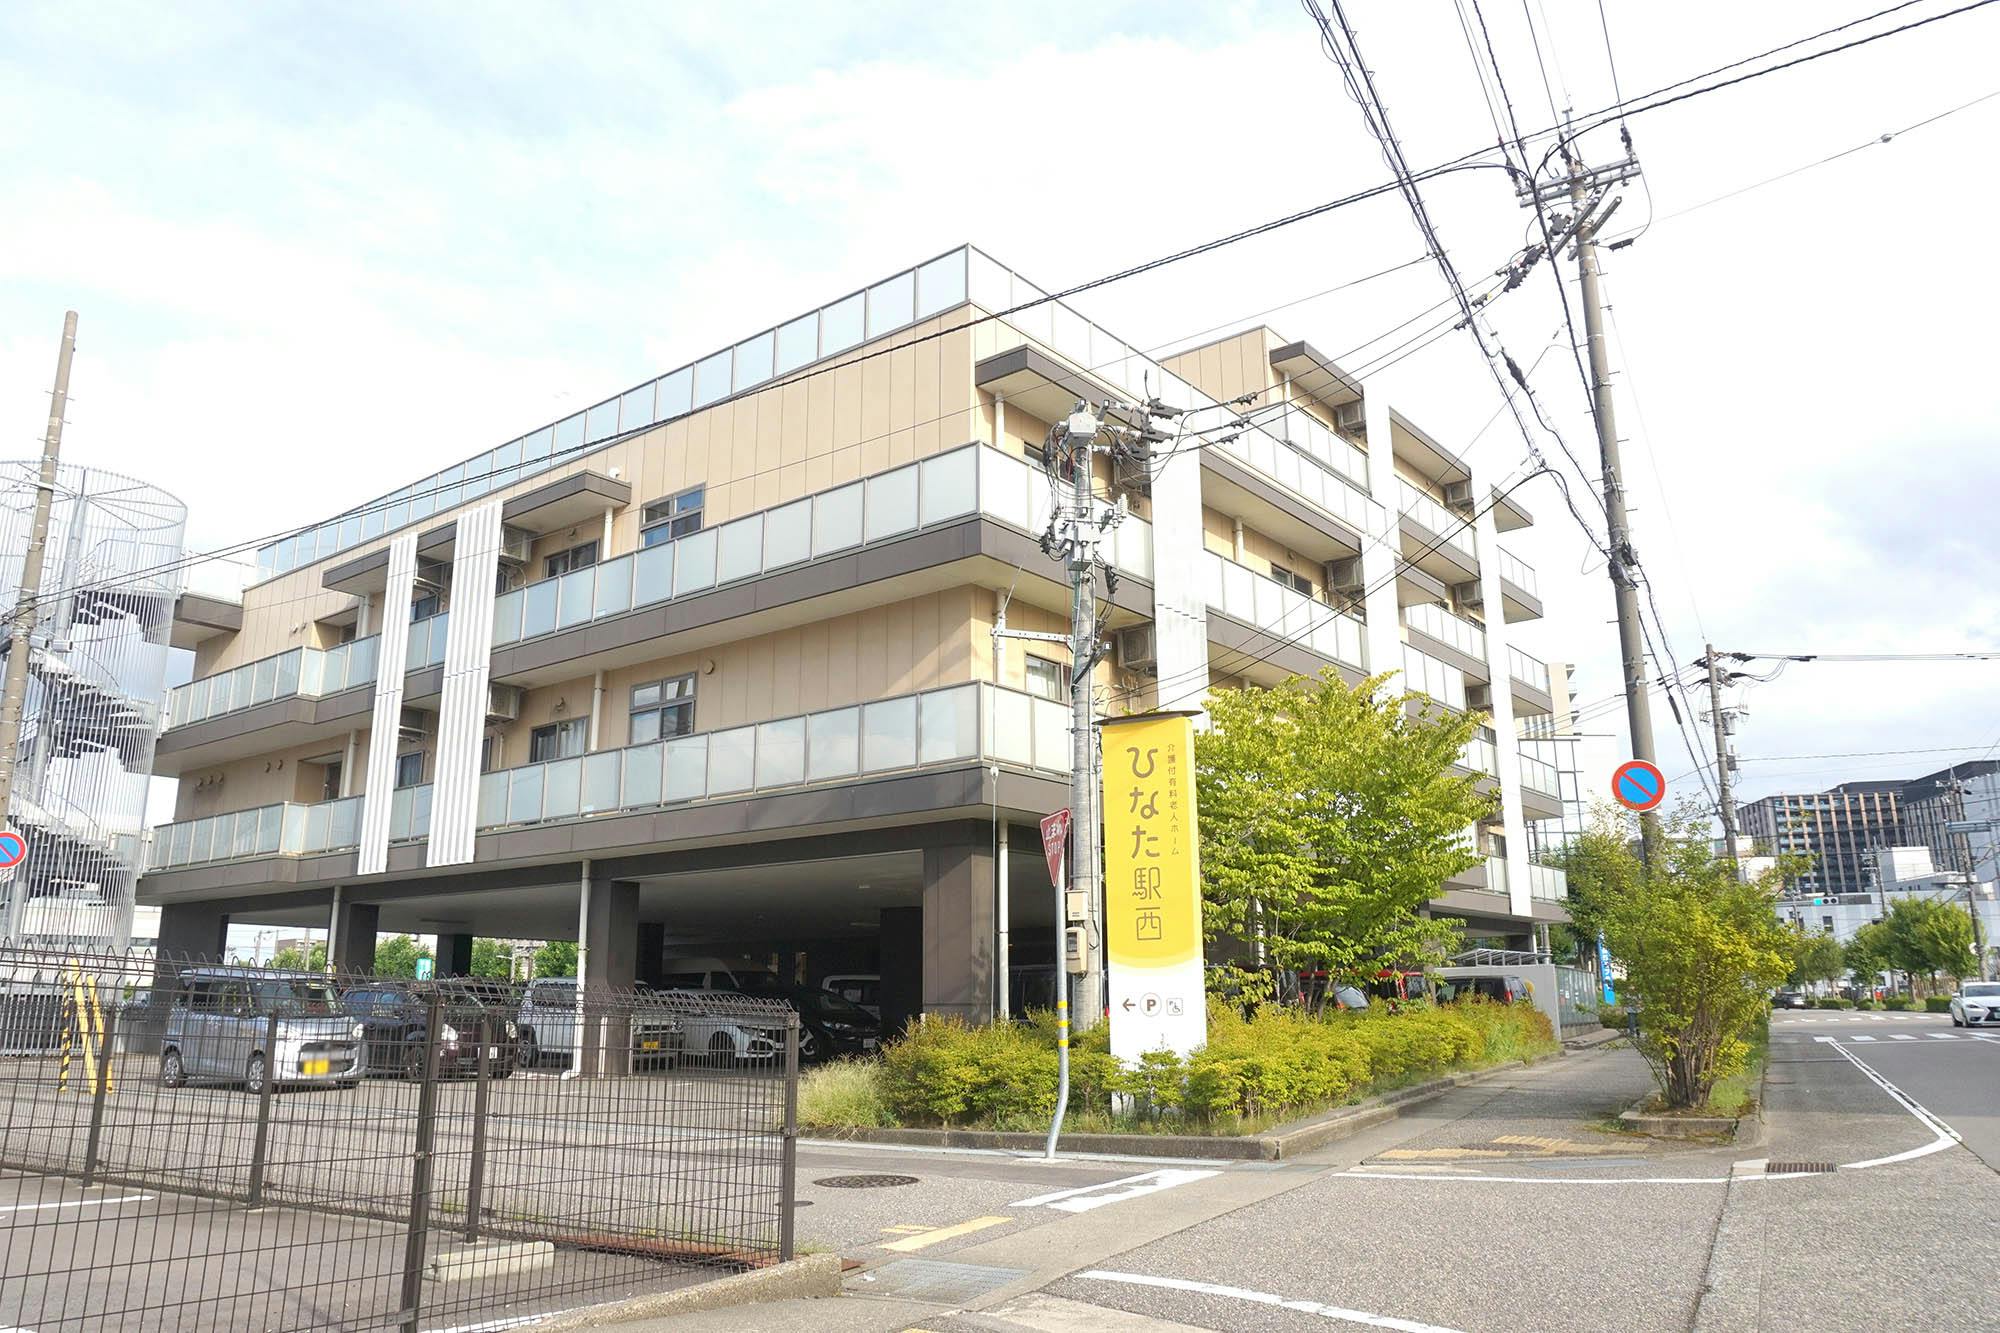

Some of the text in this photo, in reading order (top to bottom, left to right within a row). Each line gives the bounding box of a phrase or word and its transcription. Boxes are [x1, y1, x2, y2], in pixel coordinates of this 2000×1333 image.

[1126, 746, 1163, 941] ひなた駅西
[1167, 743, 1180, 856] 介護付有料老人ホーム
[1147, 999, 1157, 1012] P
